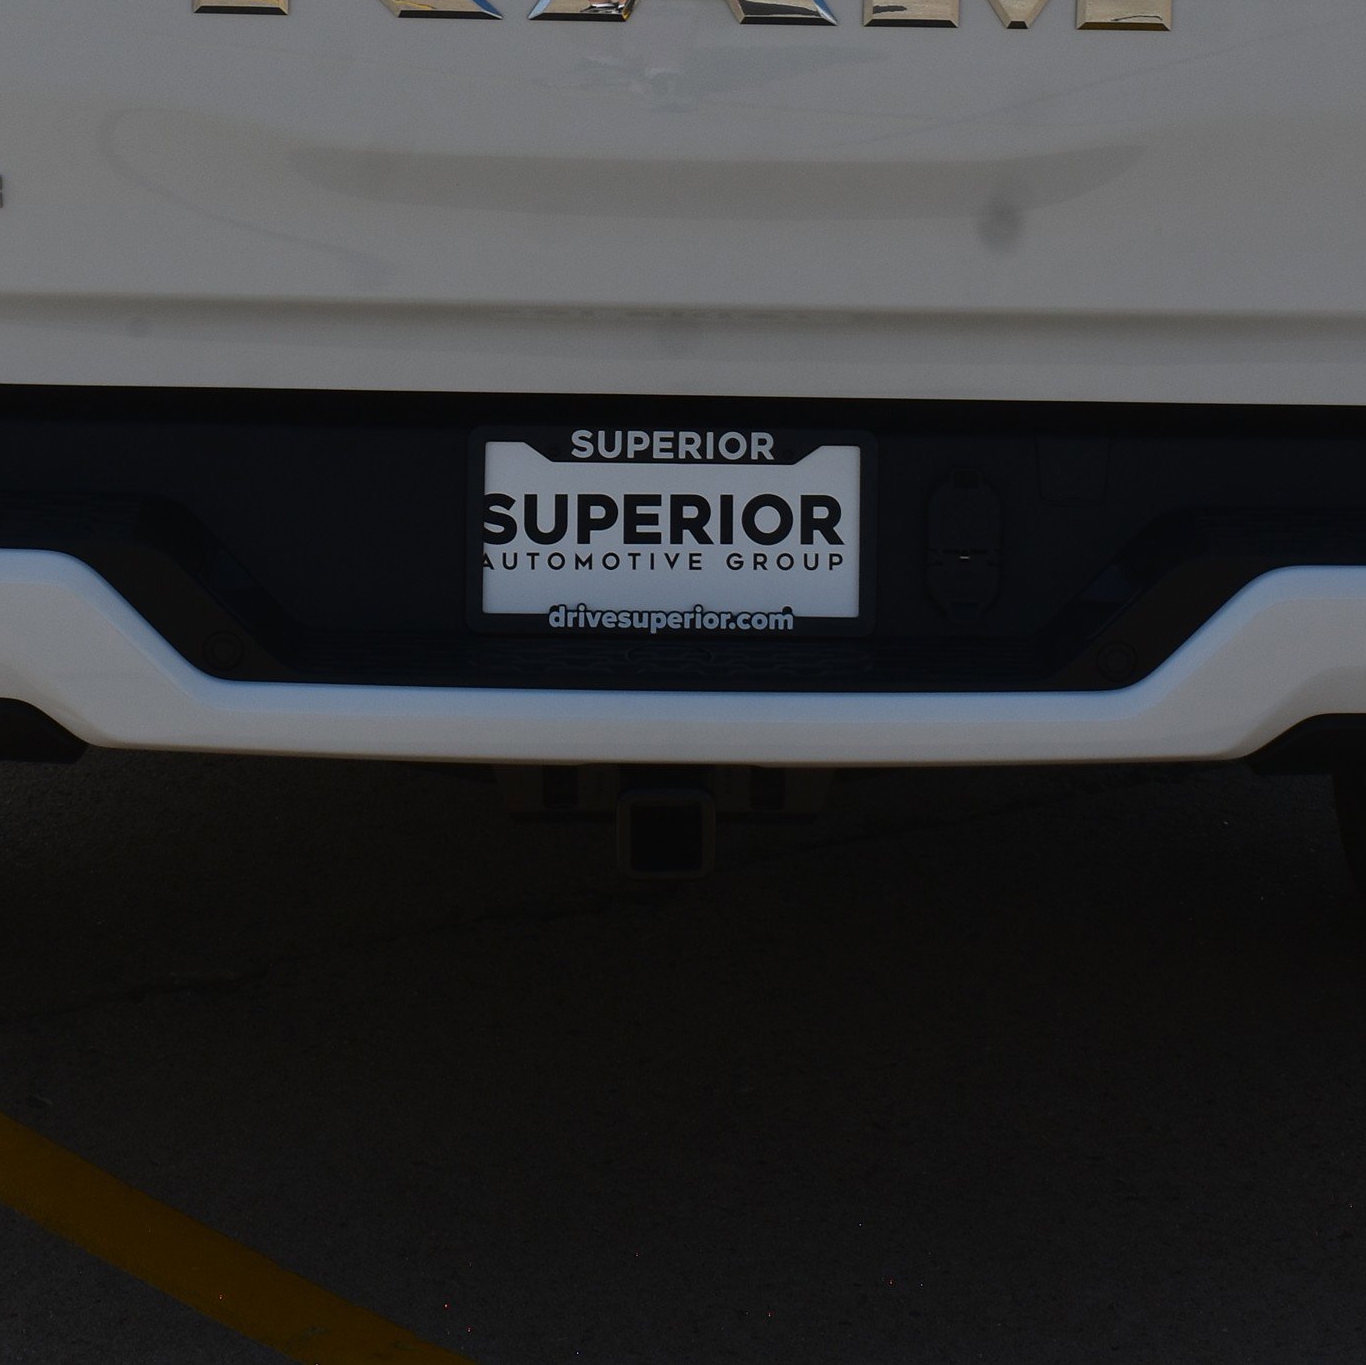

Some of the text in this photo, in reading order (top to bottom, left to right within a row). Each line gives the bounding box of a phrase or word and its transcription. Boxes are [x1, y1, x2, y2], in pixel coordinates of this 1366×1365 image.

[570, 429, 776, 462] SUPERIOR
[482, 493, 845, 546] SUPERIOR
[483, 552, 844, 571] AUTOMOTIVE GROUP
[548, 602, 795, 634] drivesuperior.com
